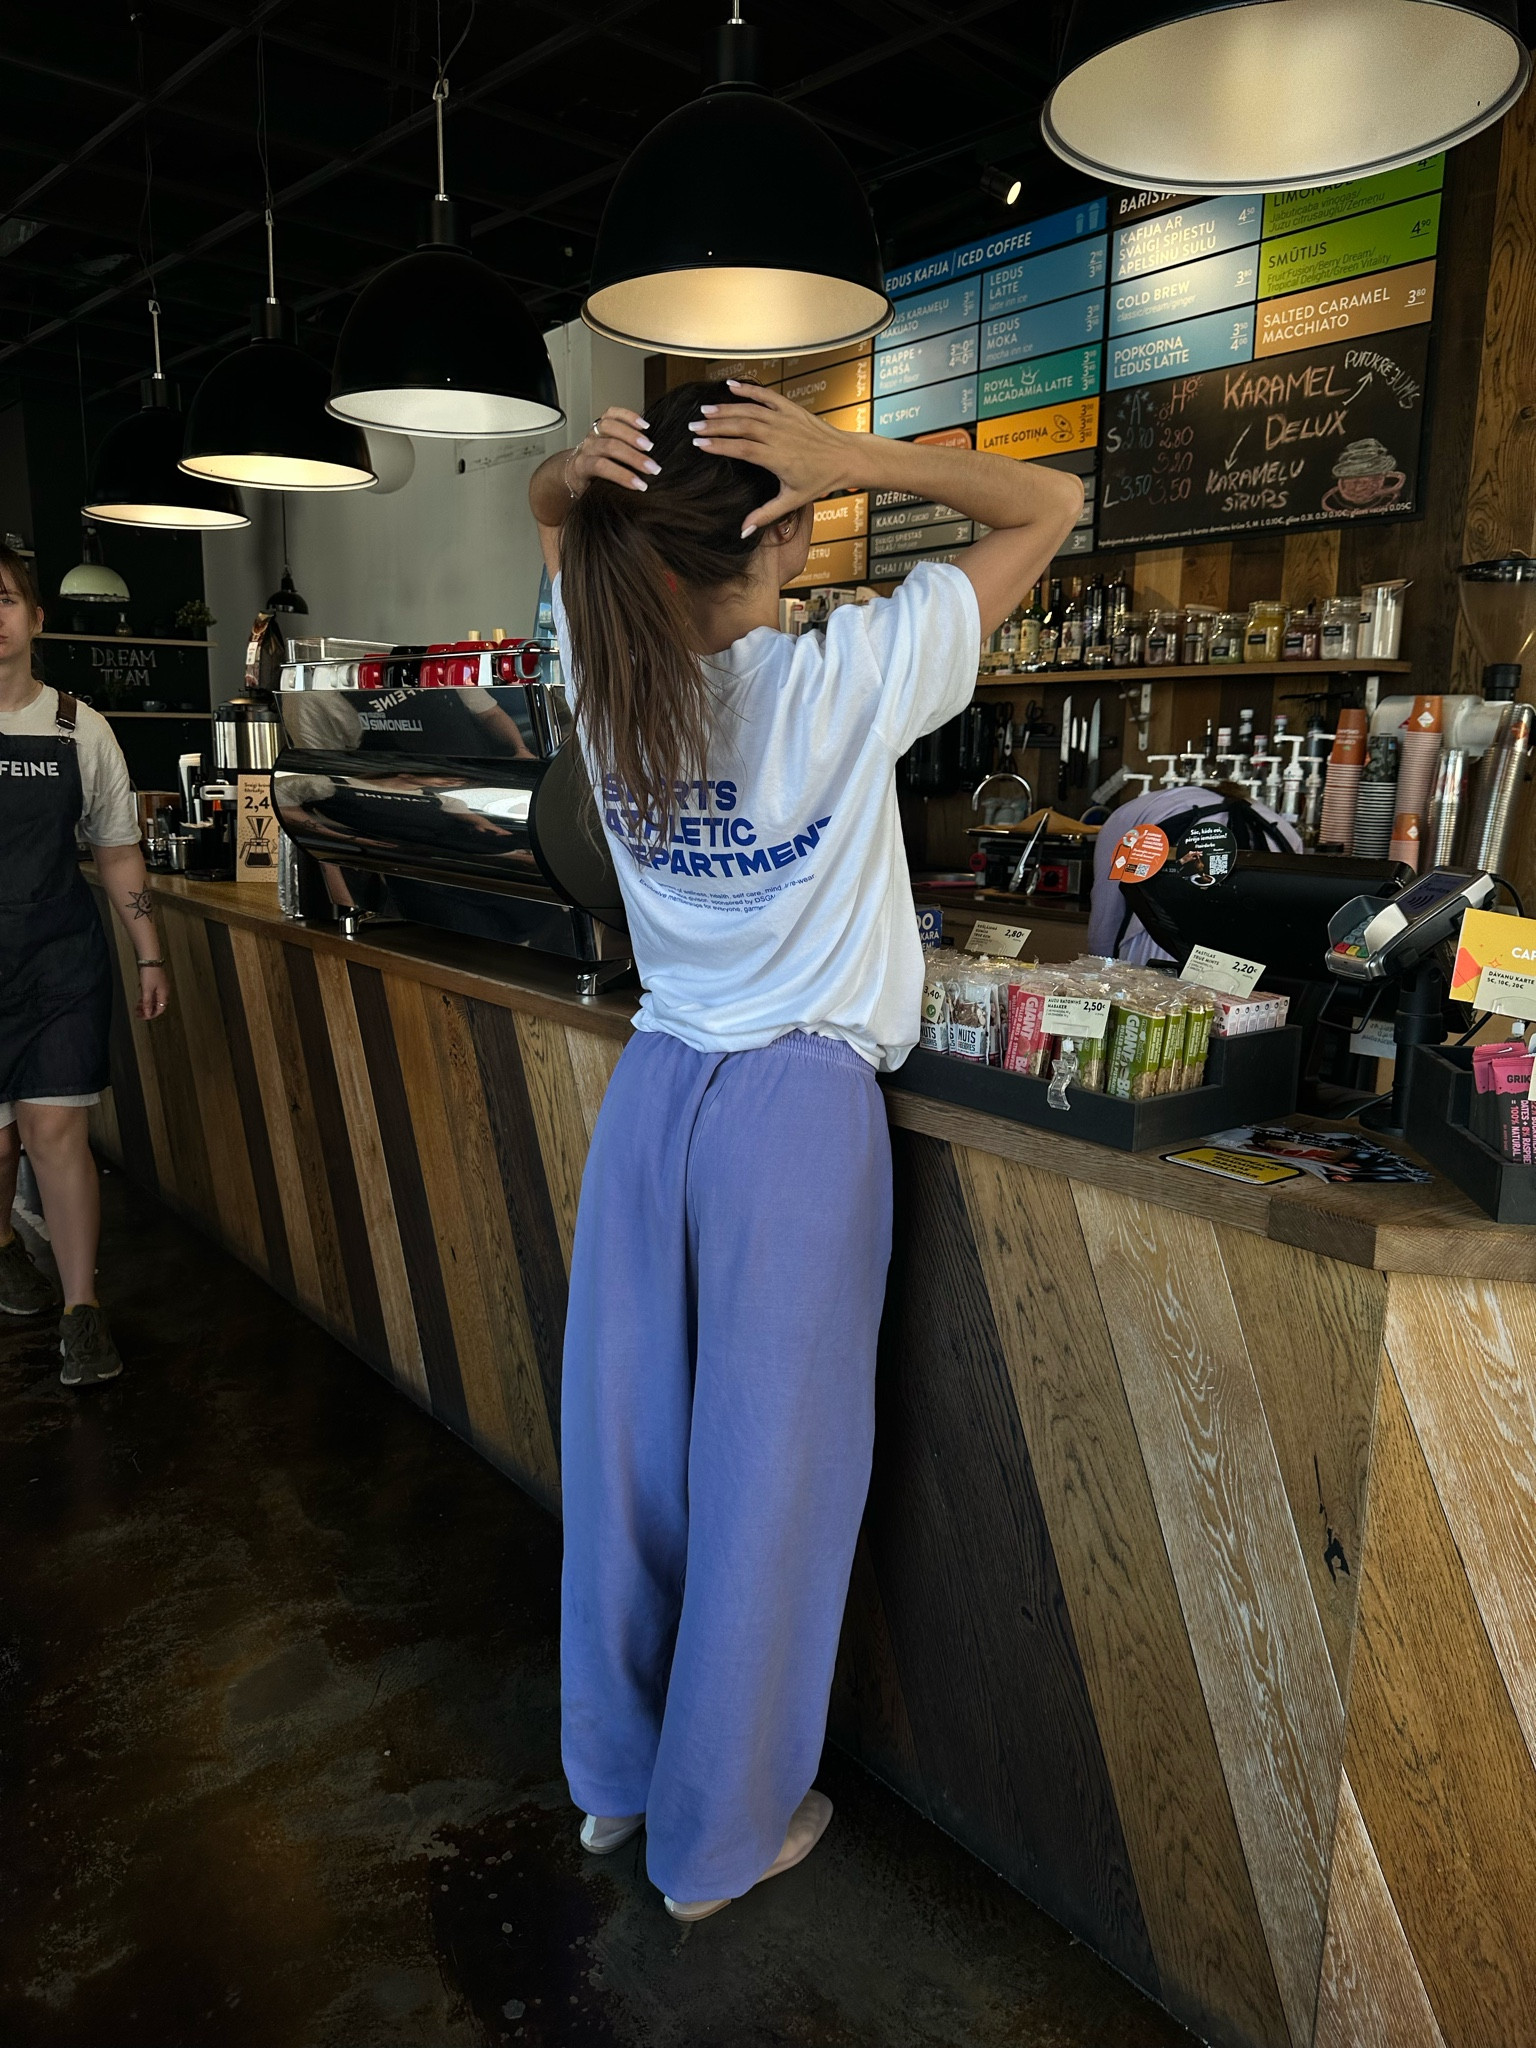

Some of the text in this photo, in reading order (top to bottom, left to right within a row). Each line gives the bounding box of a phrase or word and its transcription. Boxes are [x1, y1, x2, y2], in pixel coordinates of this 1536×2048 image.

[1119, 220, 1216, 261] SVAIGI SPIESTU
[1120, 216, 1183, 246] KAFIJA AR
[957, 231, 1032, 268] ICED COFFEE
[1184, 236, 1217, 255] SULU
[1268, 241, 1327, 269] SMŪTIJS
[885, 261, 949, 293] EDUS KAFIJA
[989, 265, 1024, 286] LEDUS
[989, 281, 1020, 300] LATTE
[1116, 280, 1190, 310] COLD BREW
[1263, 287, 1391, 329] SALTED CARAMEL
[987, 317, 1020, 337] LEDUS
[1262, 313, 1350, 345] MACCHIATO
[986, 333, 1017, 350] MOKA
[1114, 336, 1183, 363] POPKORNA
[880, 348, 915, 367] FRAPPE
[1113, 357, 1152, 379] LEDUS
[1153, 348, 1190, 369] LATTE
[983, 381, 1043, 406] MACADAMIA
[1045, 375, 1074, 393] LATTE
[984, 377, 1015, 393] ROYAL
[1223, 365, 1351, 410] KARAMEL
[879, 405, 921, 426] ICY SPICY
[983, 433, 1009, 449] LATTE
[1011, 427, 1048, 443] GOTIŅA
[875, 513, 906, 528] KAKAO
[91, 646, 157, 668] DREAM
[370, 719, 424, 732] SIMONELLI
[0, 760, 60, 777] FEINE
[604, 772, 738, 811] SRTS
[629, 815, 832, 878] EPARTMEN
[1515, 976, 1535, 985] KARTE
[1020, 996, 1039, 1041] GIANT
[958, 1029, 976, 1043] NUTS
[1122, 1014, 1140, 1063] GIANT
[1512, 1126, 1521, 1157] NATURAL
